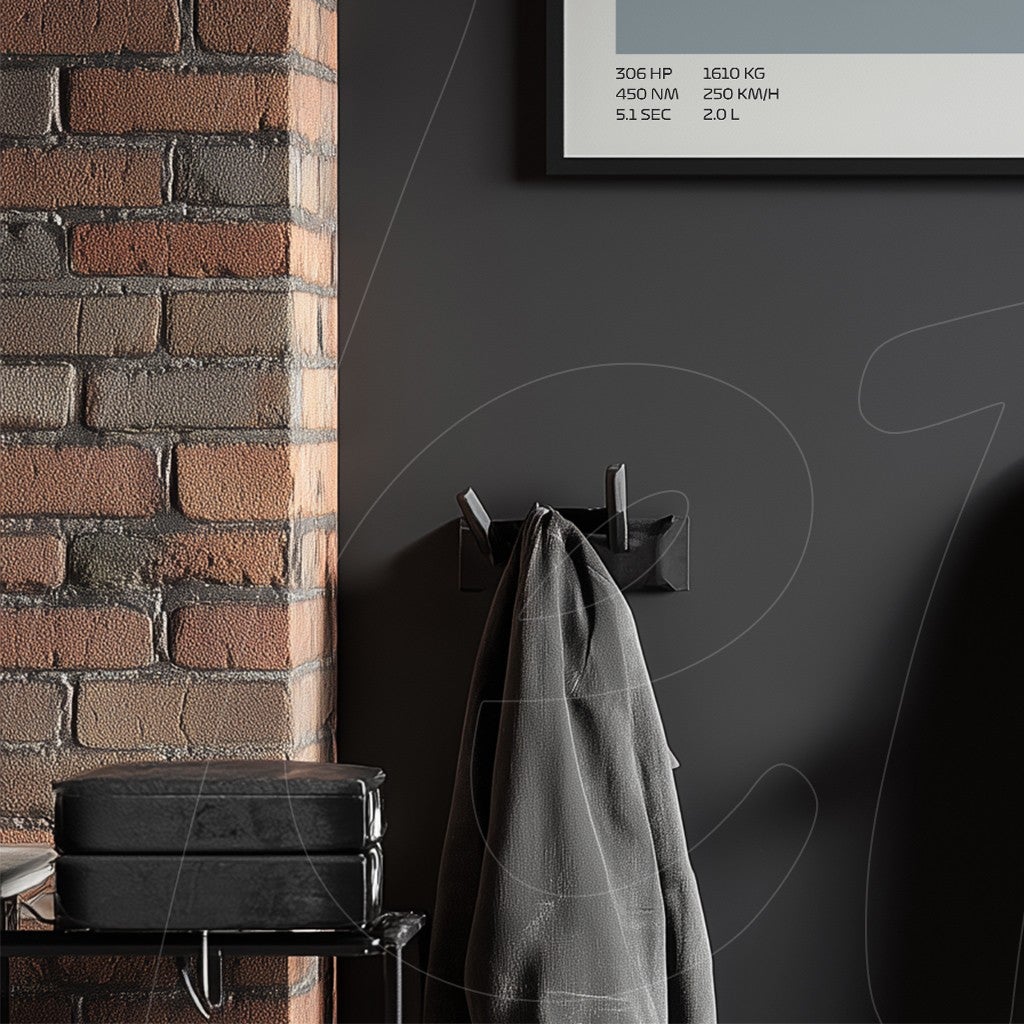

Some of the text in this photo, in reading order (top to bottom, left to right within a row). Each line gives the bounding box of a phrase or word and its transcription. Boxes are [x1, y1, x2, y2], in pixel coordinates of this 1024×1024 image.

[615, 67, 673, 80] 306 HP
[703, 67, 766, 80] 1610 KG
[615, 87, 679, 100] 450 NM
[703, 87, 780, 102] 250 KM/H
[615, 108, 672, 121] 5.1 SEC
[703, 108, 740, 121] 2.0 L
